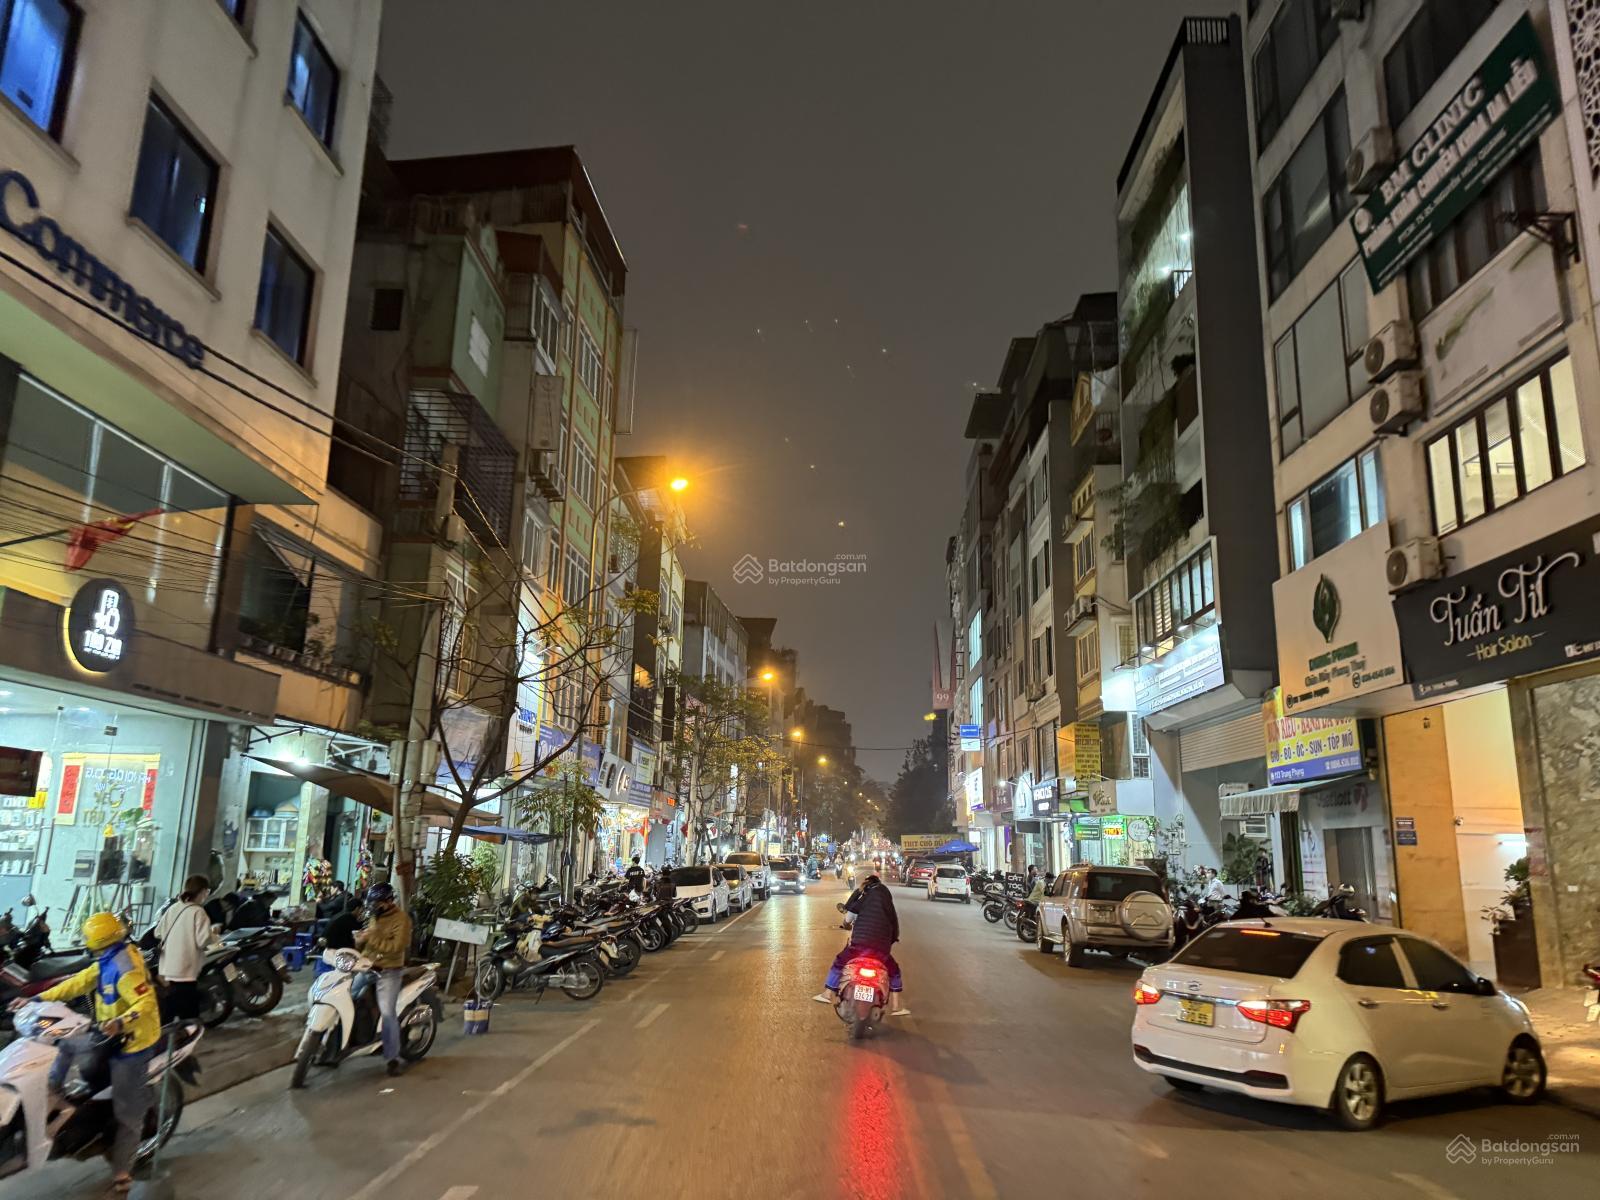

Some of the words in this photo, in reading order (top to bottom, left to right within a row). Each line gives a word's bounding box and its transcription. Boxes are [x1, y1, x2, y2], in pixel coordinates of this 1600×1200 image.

[1380, 158, 1414, 204] BM
[1412, 76, 1485, 168] CLINIC
[1430, 586, 1502, 646] Tuấn
[1475, 643, 1498, 661] Hair
[1499, 633, 1533, 655] Salon
